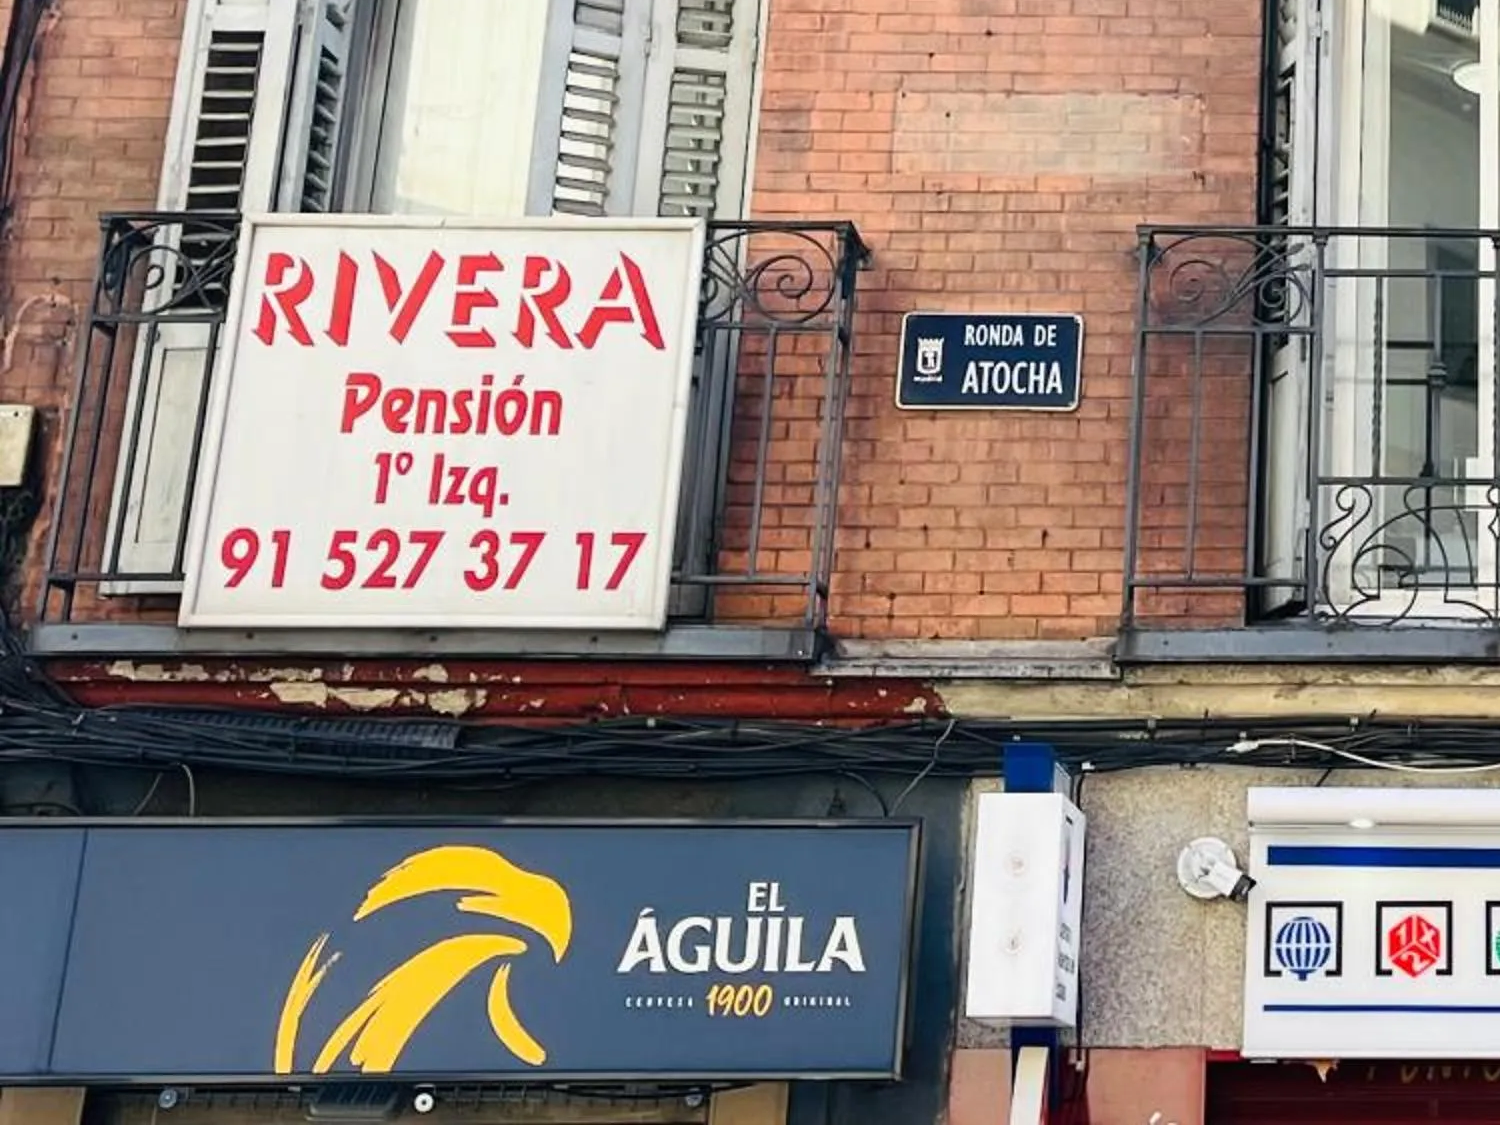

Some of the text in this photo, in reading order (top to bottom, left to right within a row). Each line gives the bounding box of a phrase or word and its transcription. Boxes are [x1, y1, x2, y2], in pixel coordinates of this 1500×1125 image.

[252, 250, 666, 349] RIVERA
[964, 324, 1057, 347] RONDA DE
[340, 372, 563, 436] Pensión
[961, 361, 1063, 394] ATOCHA
[428, 453, 509, 518] Izq.
[220, 527, 648, 592] 91 527 37 17
[747, 881, 786, 913] EL
[617, 907, 866, 974] ÁGUILA
[705, 984, 774, 1017] 1900
